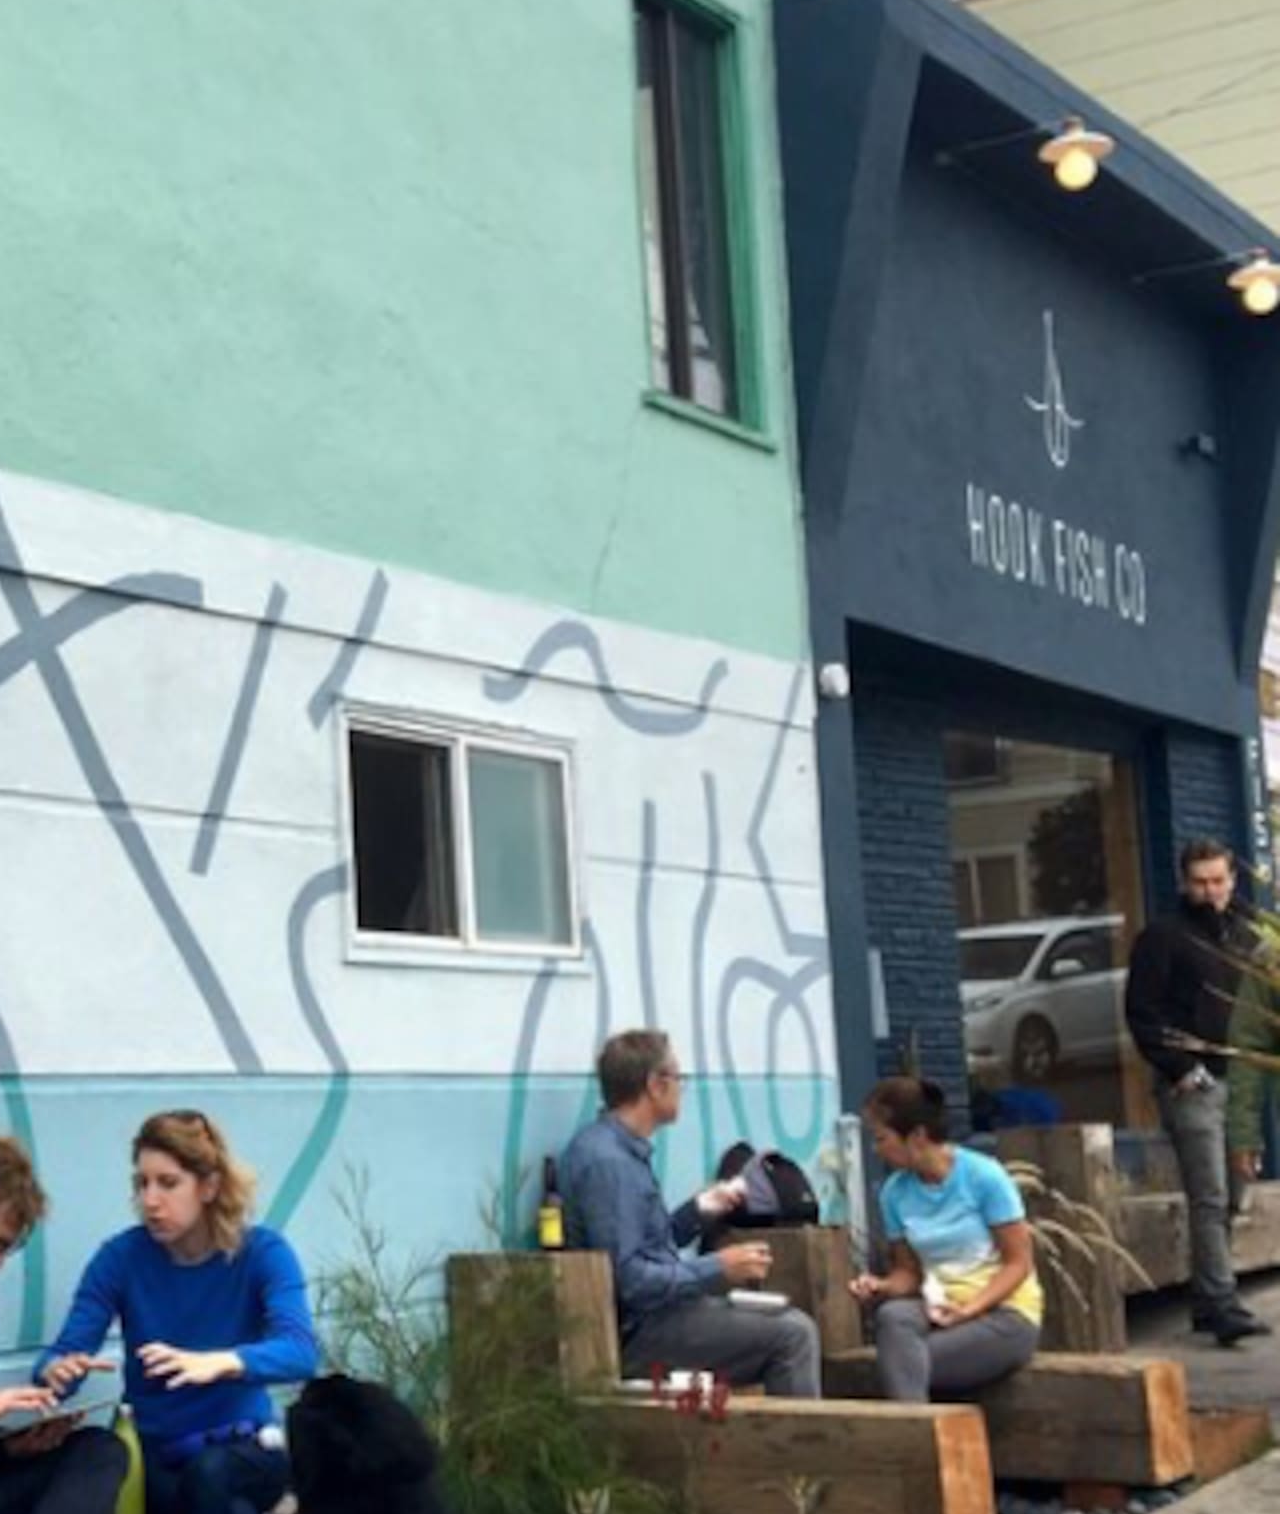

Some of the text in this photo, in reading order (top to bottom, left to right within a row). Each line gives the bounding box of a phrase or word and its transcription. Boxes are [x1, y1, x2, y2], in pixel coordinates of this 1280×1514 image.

[966, 482, 1147, 625] HOOK FISH CO
